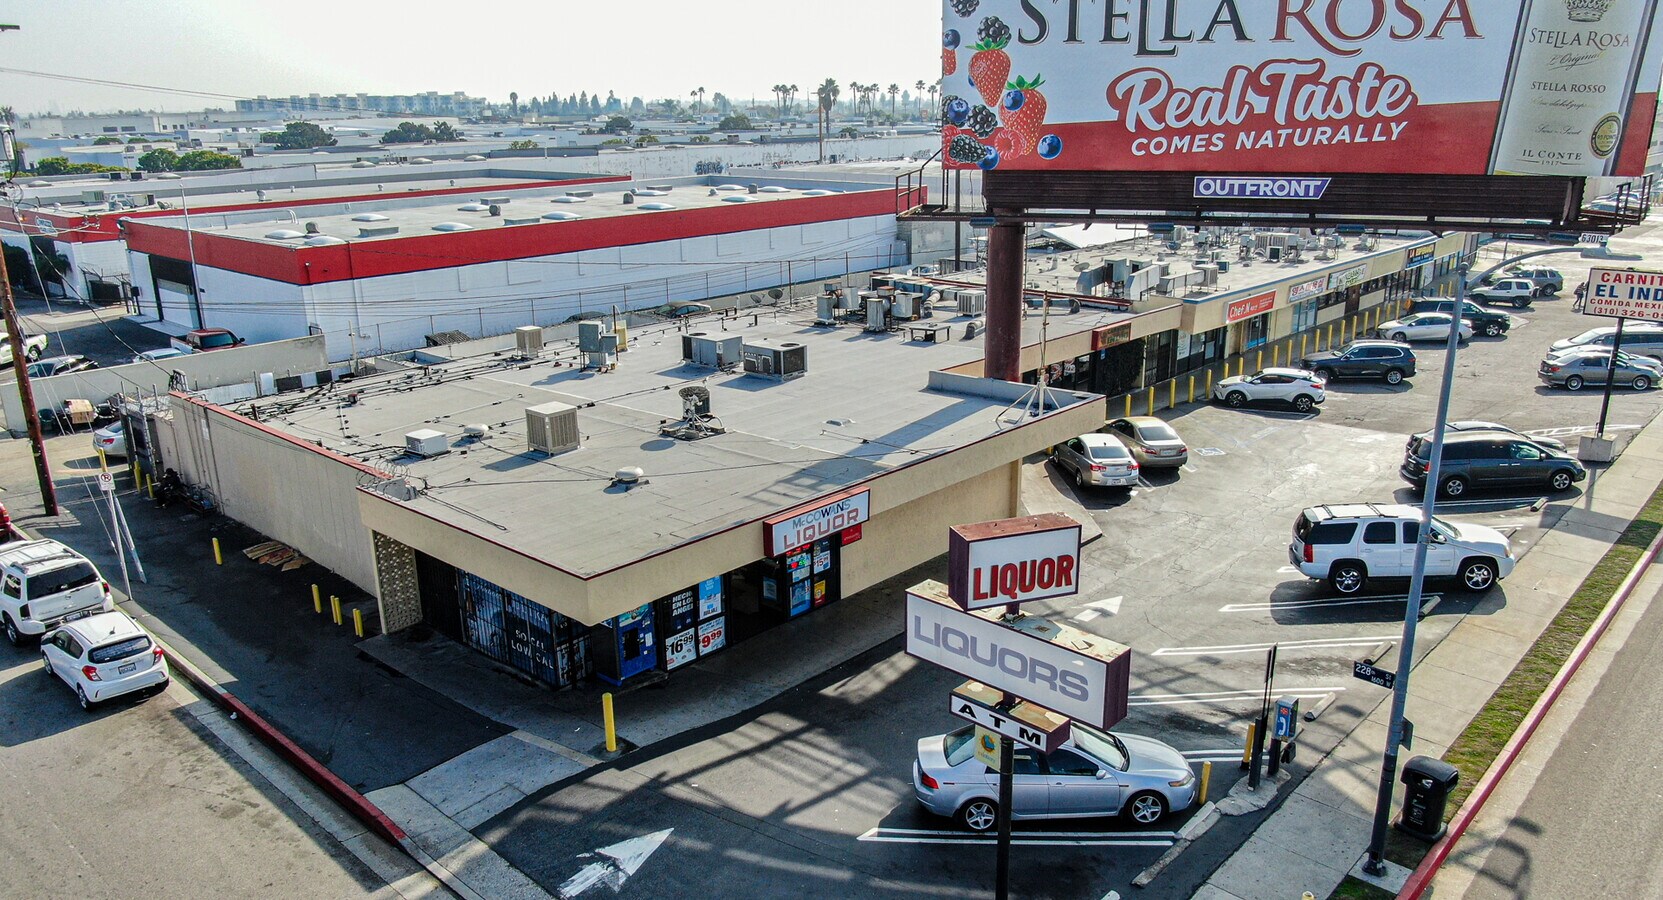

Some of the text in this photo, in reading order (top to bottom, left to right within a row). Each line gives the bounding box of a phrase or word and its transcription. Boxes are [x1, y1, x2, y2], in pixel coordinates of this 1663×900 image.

[1018, 0, 1484, 58] STELLA ROSA
[1529, 28, 1629, 50] STELLA ROSA
[1113, 60, 1413, 133] Real Taste
[1531, 81, 1606, 93] STELLA ROSSO
[1131, 121, 1408, 156] COMES NATURALLY
[1523, 149, 1582, 160] IL CONTE
[1199, 178, 1322, 196] OUTFRONT
[1595, 284, 1619, 298] EL
[1590, 298, 1663, 310] COMIDA MEXI
[1594, 307, 1619, 315] (310)
[784, 508, 859, 549] LIQUOR
[973, 554, 1074, 600] LIQUOR
[914, 615, 1089, 702] LIQUORS
